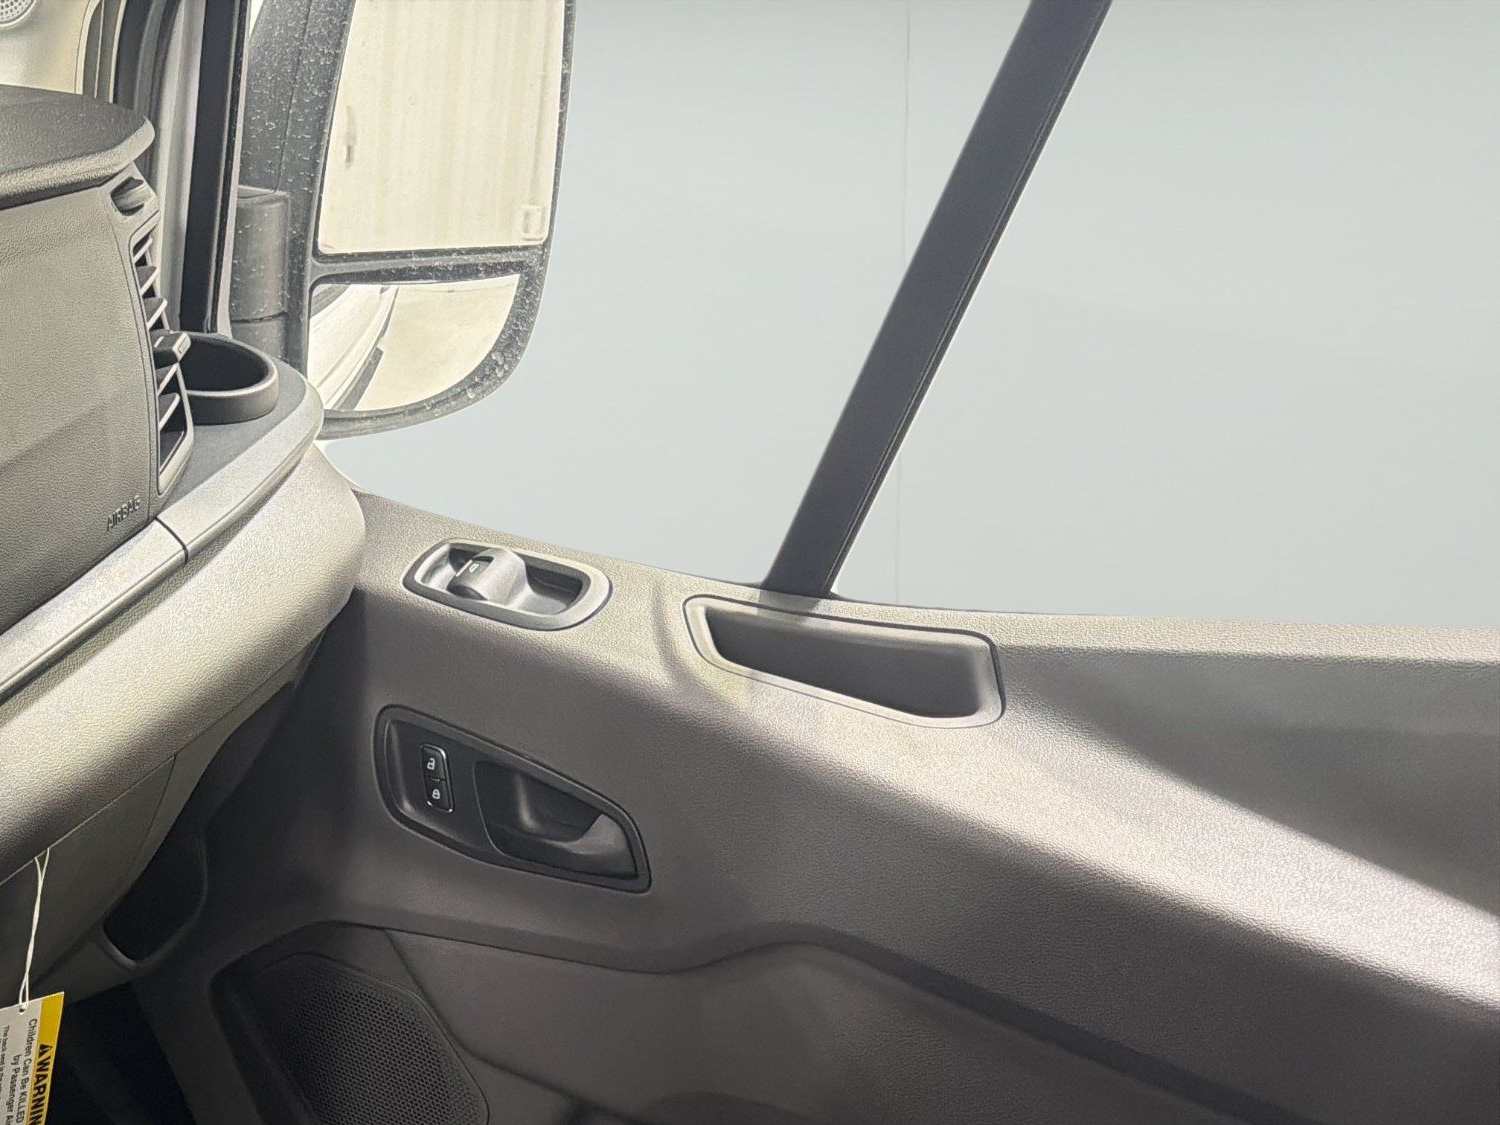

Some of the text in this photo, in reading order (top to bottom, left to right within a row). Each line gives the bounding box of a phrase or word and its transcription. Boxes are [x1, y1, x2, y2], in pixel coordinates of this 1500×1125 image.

[24, 1017, 37, 1057] Children
[10, 1053, 21, 1066] by
[21, 1057, 32, 1076] Can
[4, 1067, 20, 1114] Passenger
[19, 1076, 29, 1090] Be
[15, 1090, 27, 1124] KILLED
